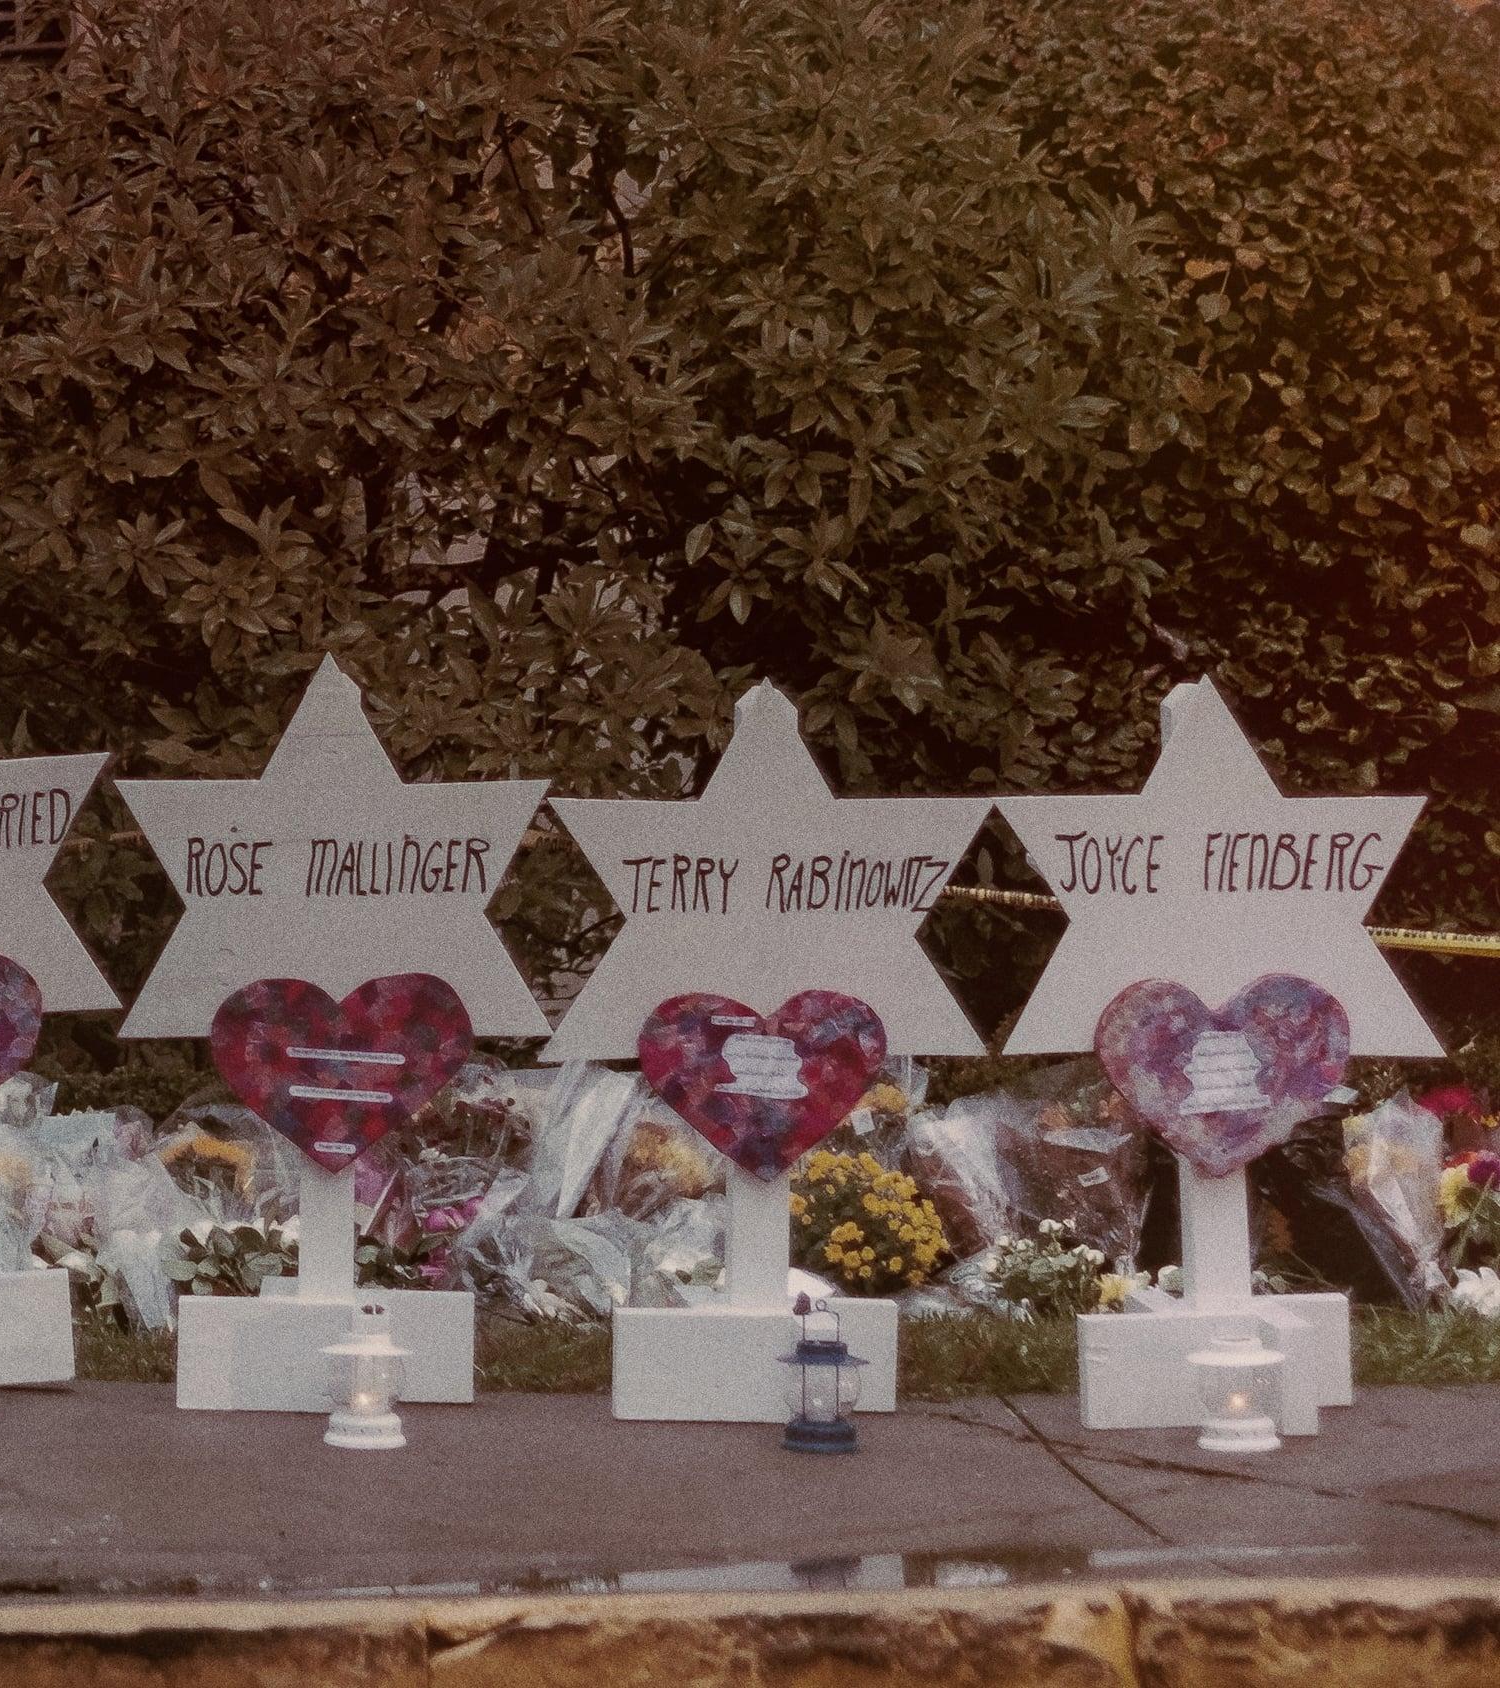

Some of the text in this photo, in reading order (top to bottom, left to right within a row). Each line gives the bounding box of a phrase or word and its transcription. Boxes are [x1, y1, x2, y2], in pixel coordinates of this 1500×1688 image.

[186, 837, 273, 897] ROSE
[623, 853, 738, 914] TERRY
[1055, 830, 1384, 895] JOYCE FIENBERG
